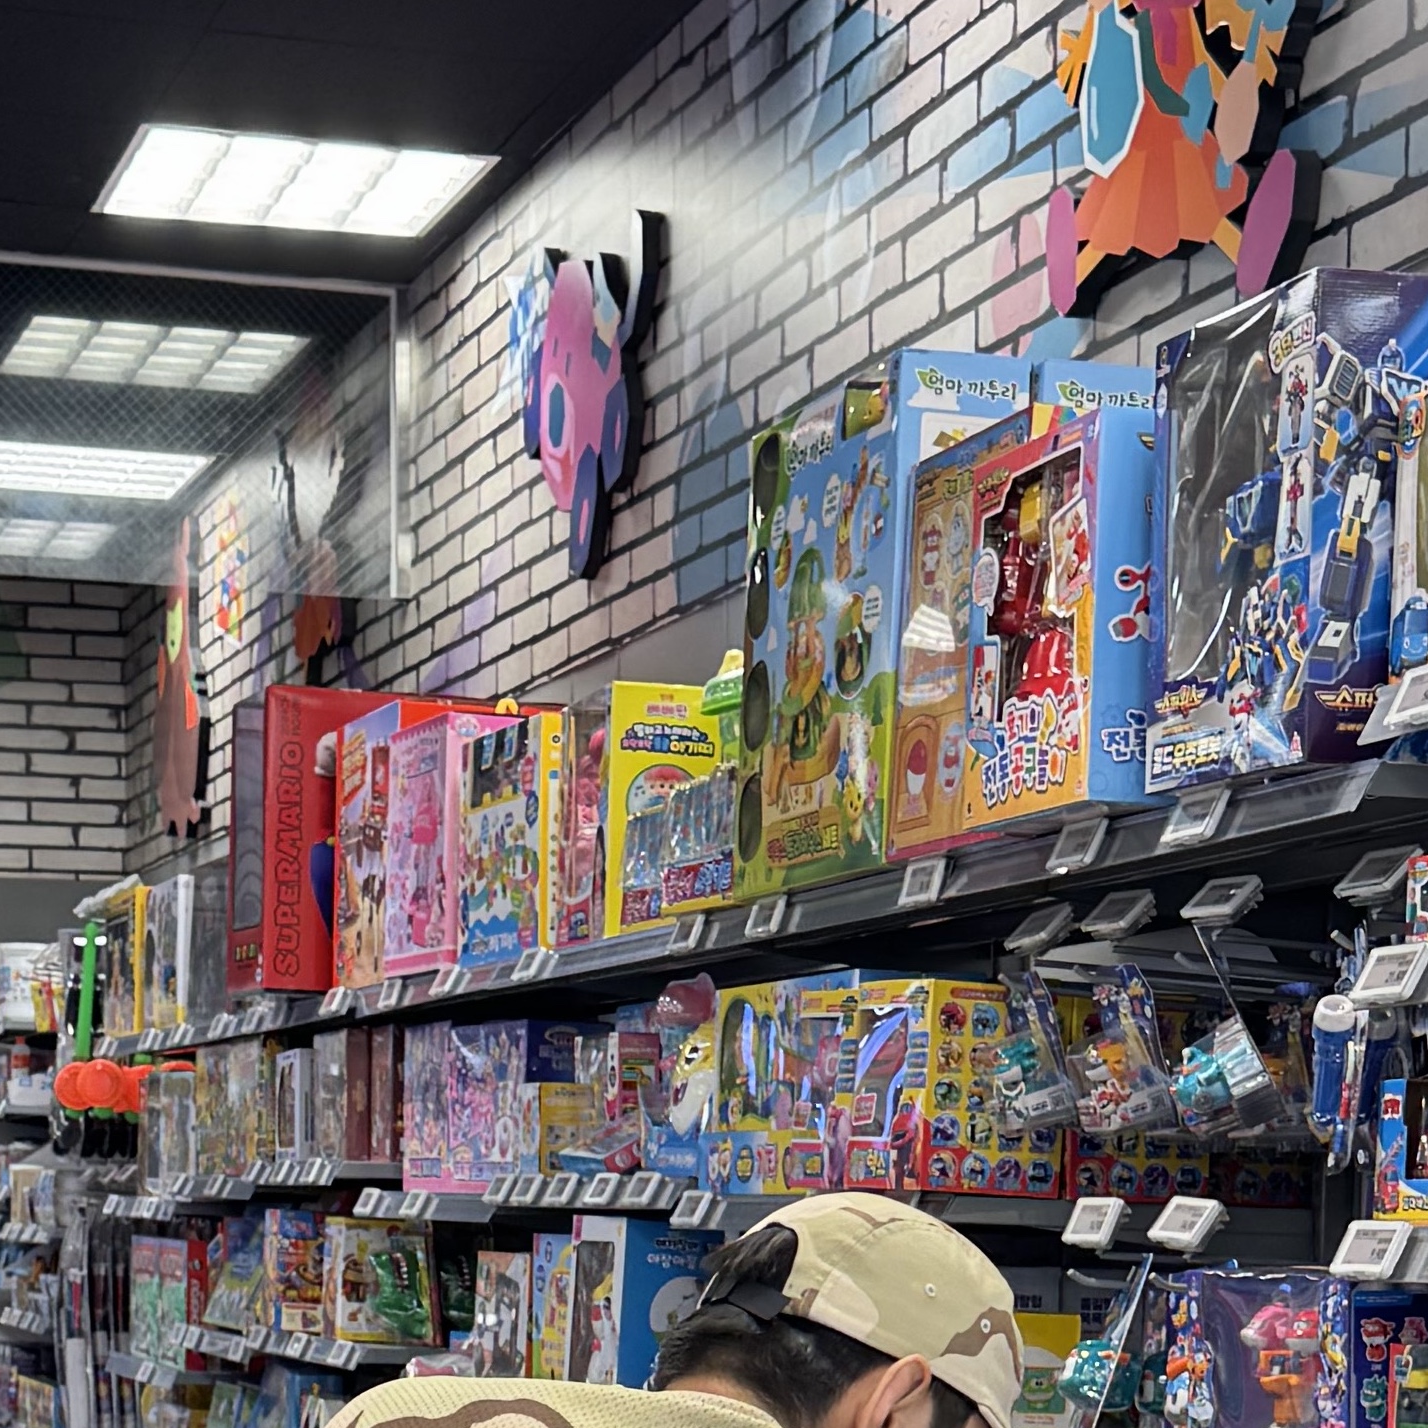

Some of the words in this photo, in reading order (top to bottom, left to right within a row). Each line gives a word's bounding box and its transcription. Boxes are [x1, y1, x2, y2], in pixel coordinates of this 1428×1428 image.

[927, 372, 963, 396] 엄마
[966, 380, 1016, 402] 까투리
[1068, 384, 1106, 407] 엄마
